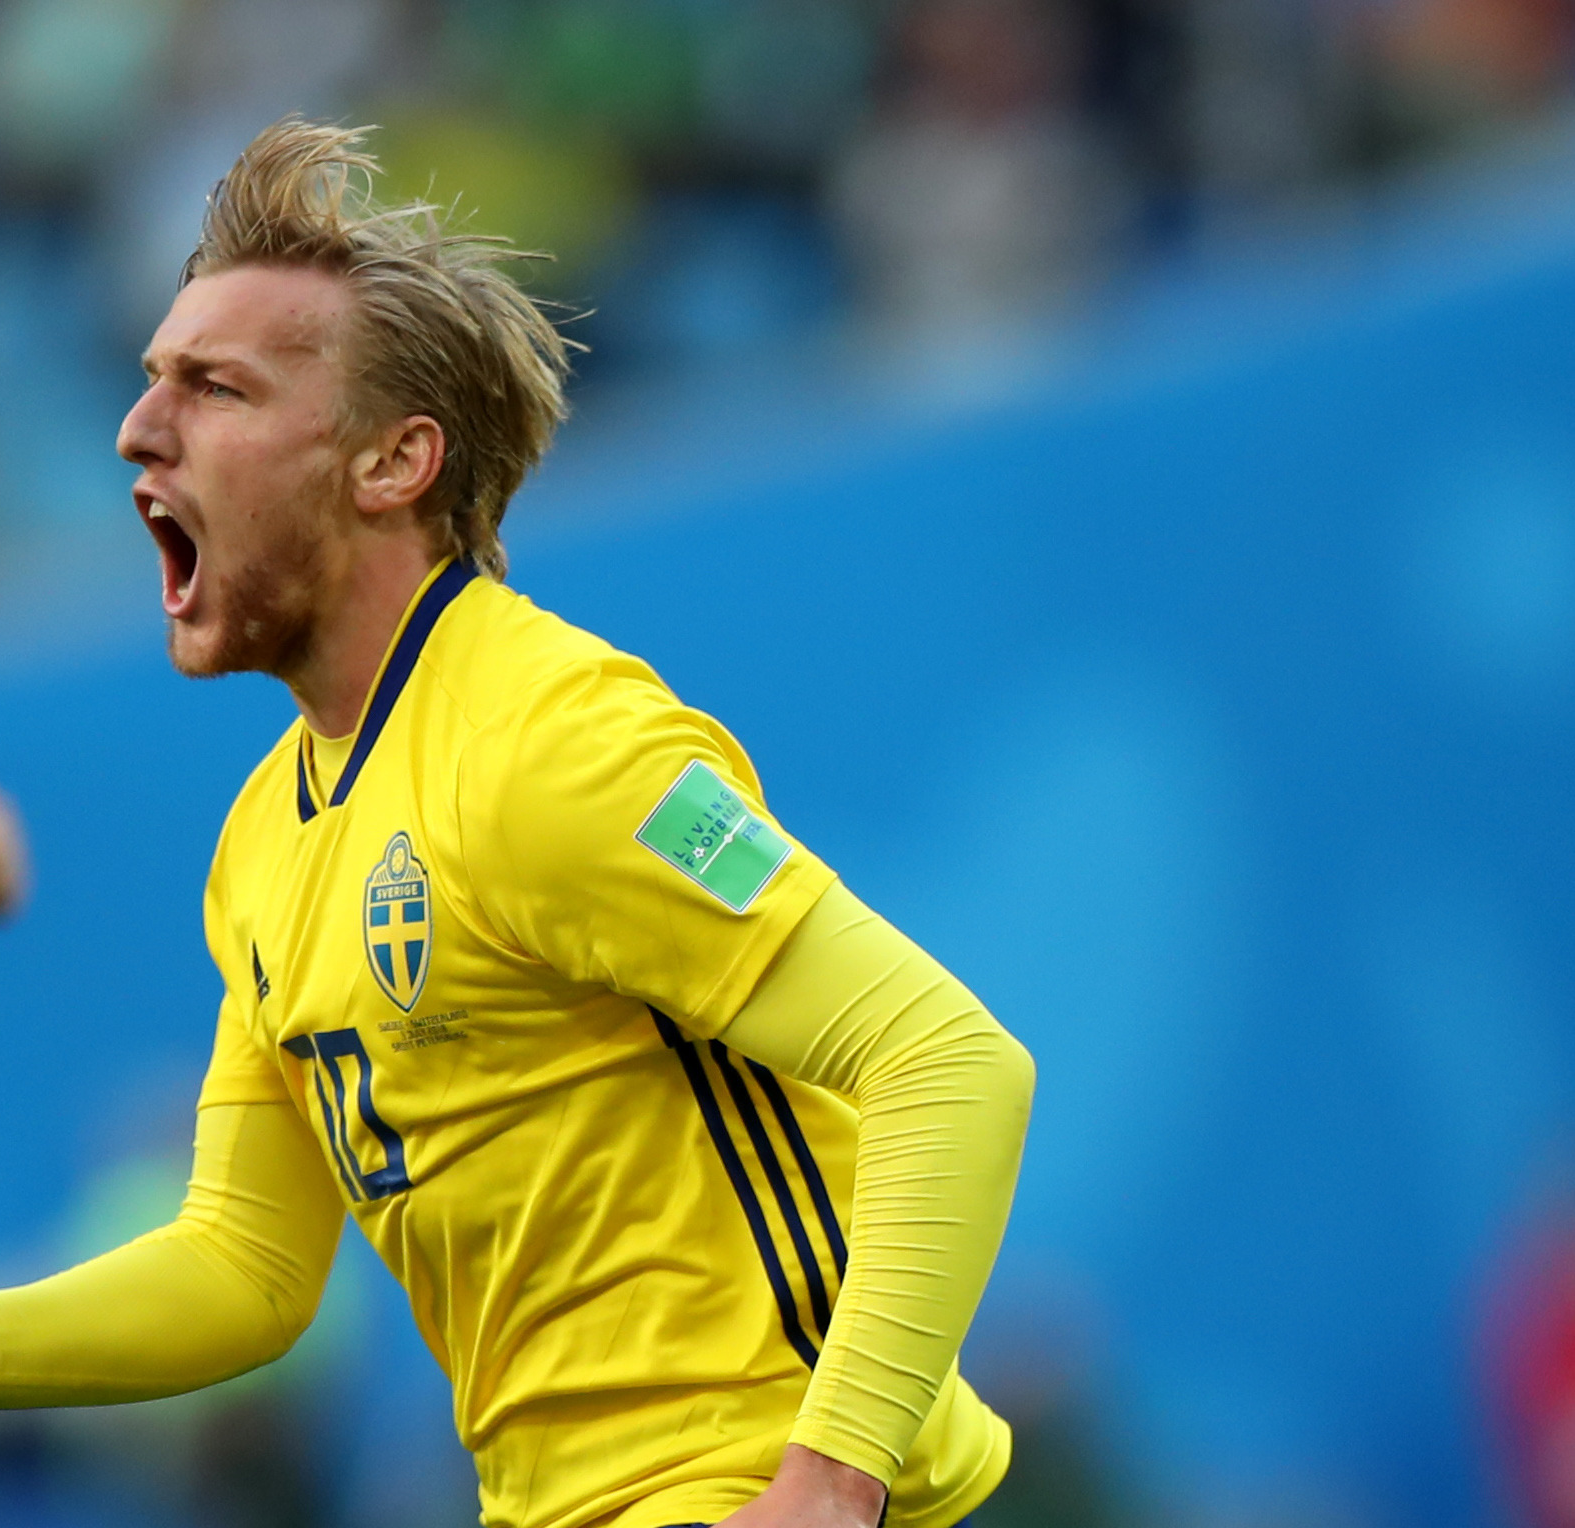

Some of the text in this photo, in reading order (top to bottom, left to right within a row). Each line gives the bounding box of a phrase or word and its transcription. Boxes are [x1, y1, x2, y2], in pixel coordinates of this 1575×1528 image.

[673, 791, 731, 859] LIVING
[741, 822, 763, 843] FIFA
[376, 884, 419, 900] SVERIGE
[279, 1027, 415, 1202] 10
